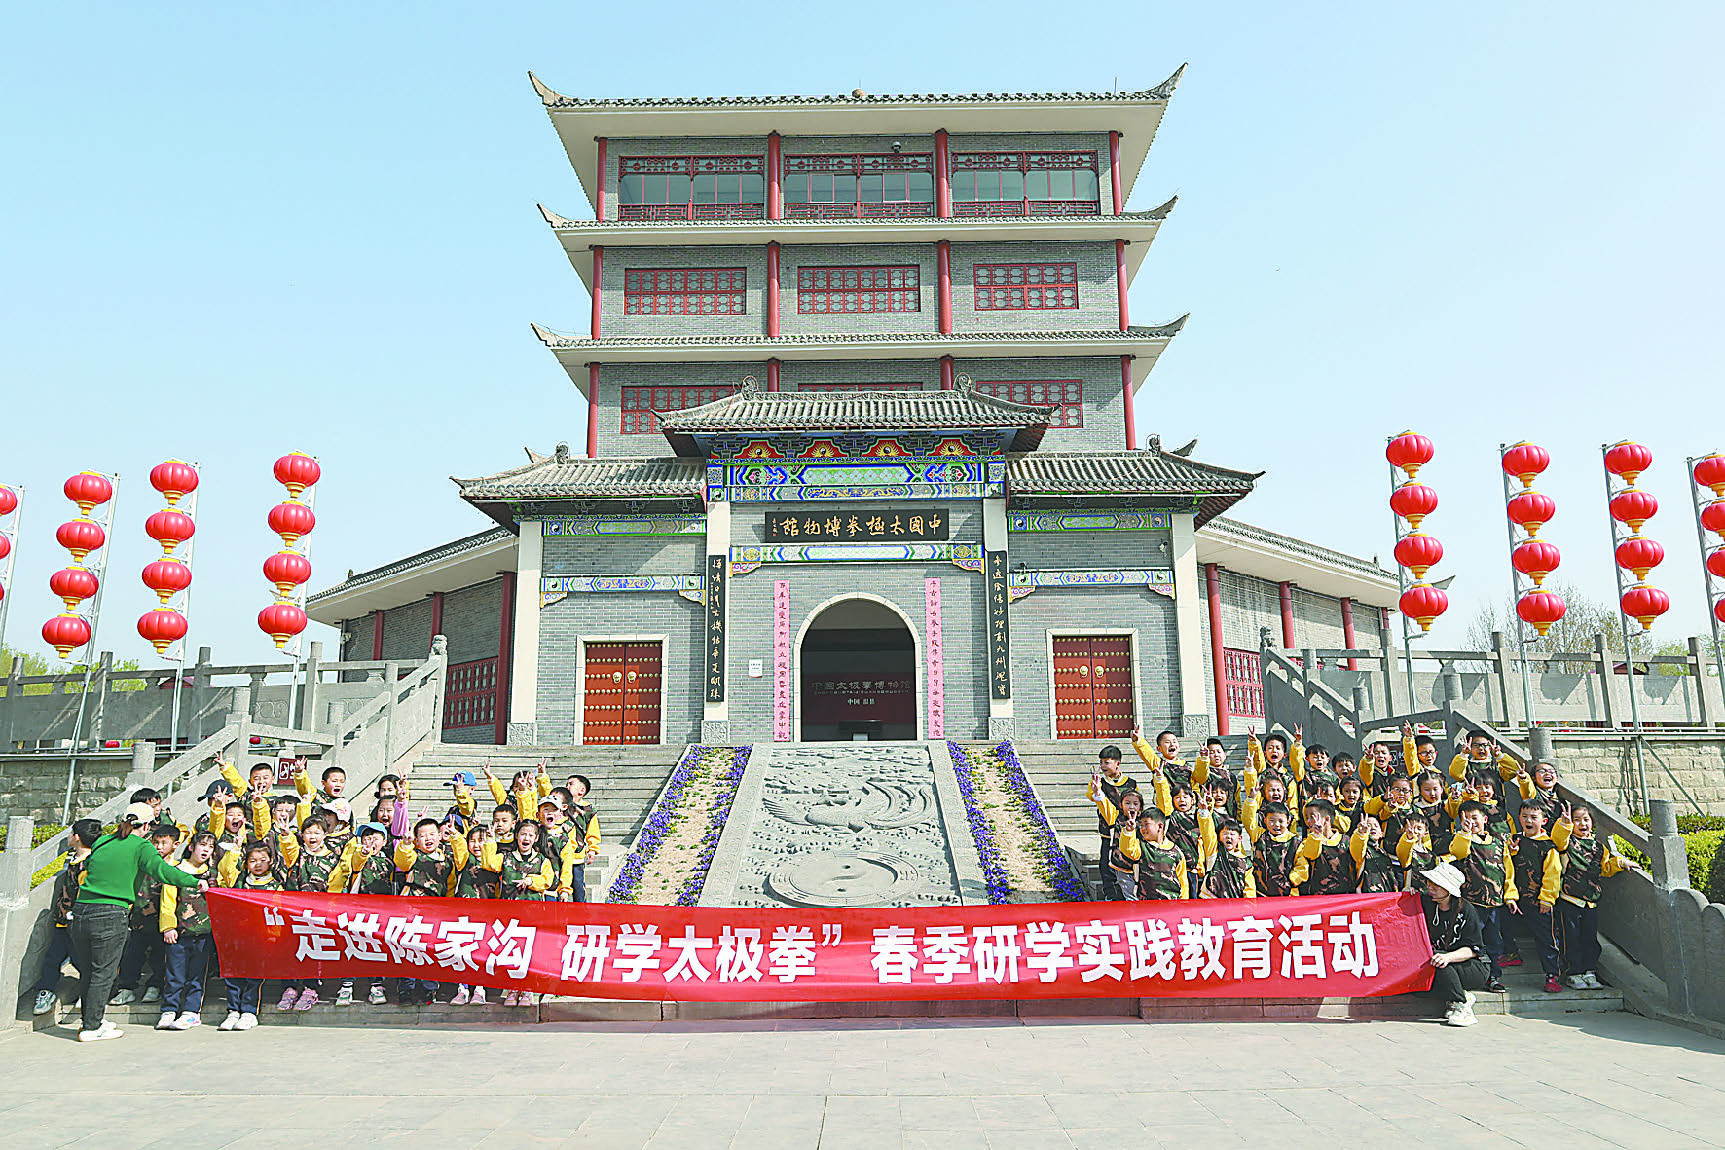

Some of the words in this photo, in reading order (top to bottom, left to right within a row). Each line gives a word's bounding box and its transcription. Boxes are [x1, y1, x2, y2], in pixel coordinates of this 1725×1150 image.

[779, 514, 942, 537] 中國太極拳博物館
[264, 907, 536, 979] “走进陈家沟
[561, 923, 841, 983] 研学太极拳”
[871, 911, 1379, 984] 春季研学实践教育活动
